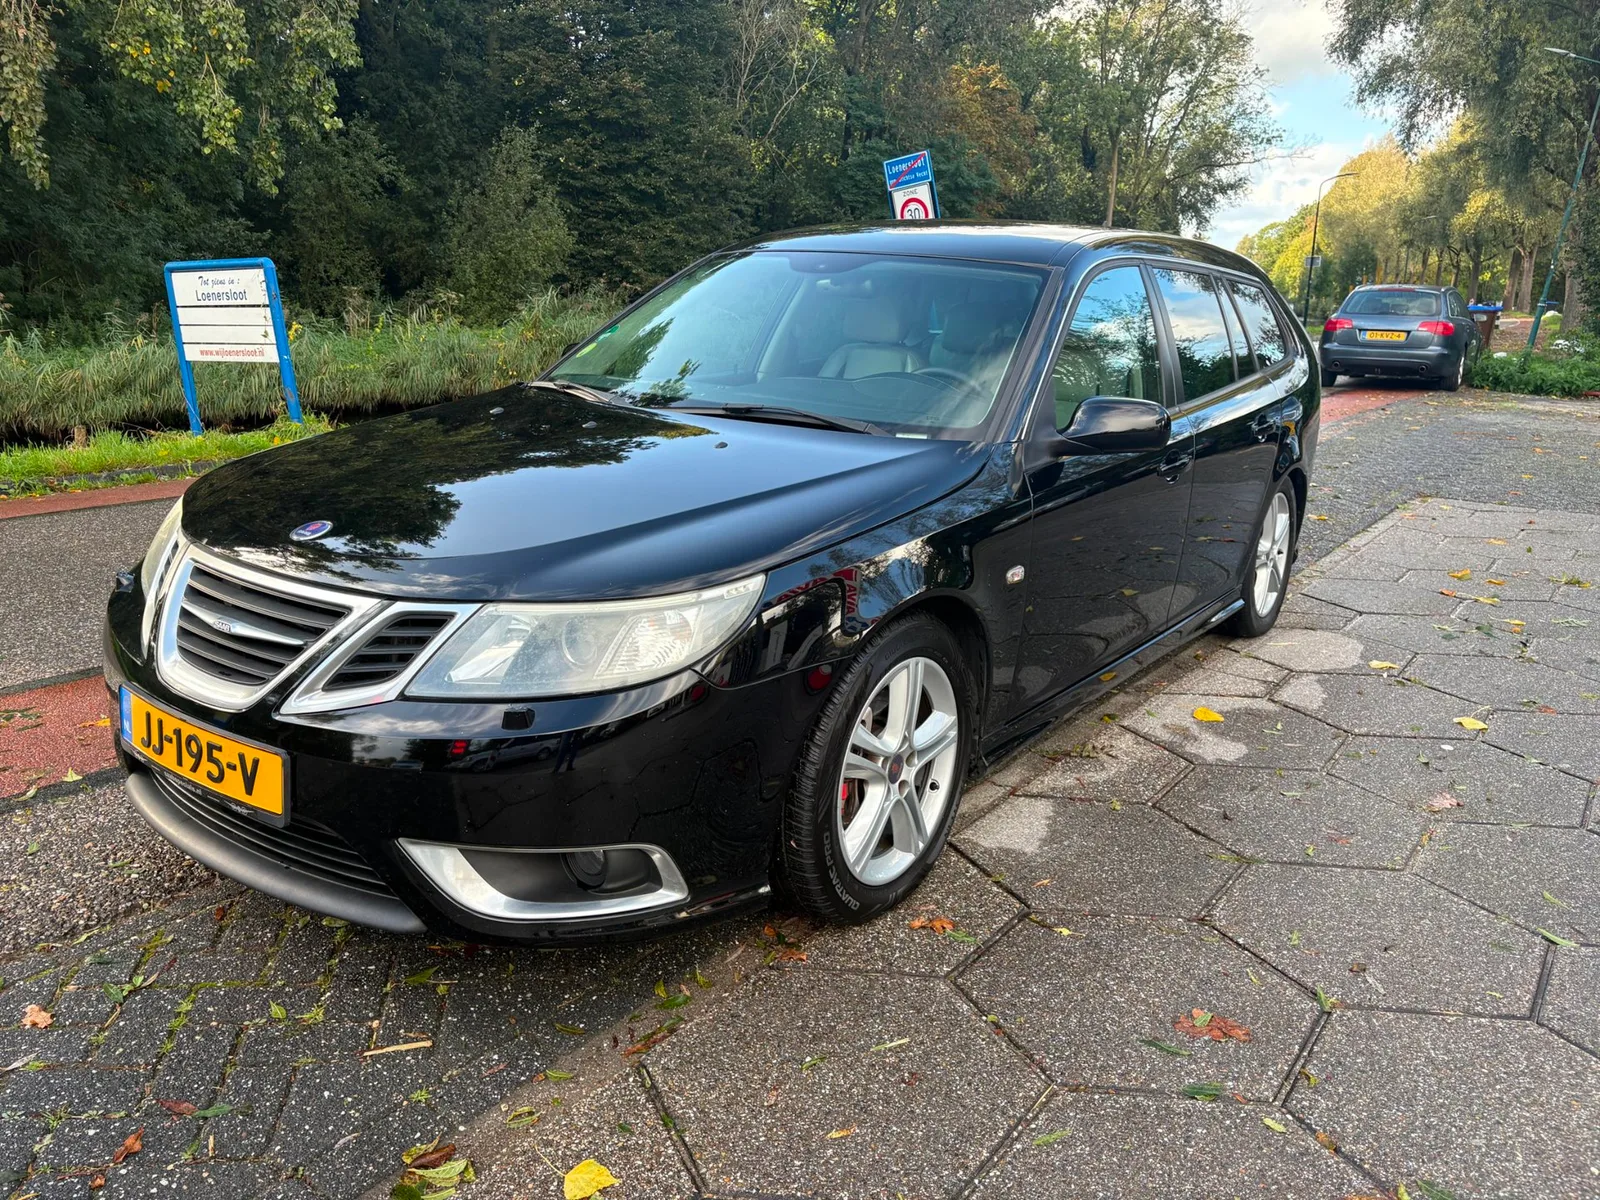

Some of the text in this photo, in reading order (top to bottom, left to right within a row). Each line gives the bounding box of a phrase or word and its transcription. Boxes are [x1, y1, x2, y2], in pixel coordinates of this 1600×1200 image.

[888, 157, 925, 174] Loenersloot
[903, 189, 918, 197] ZONE
[907, 207, 921, 219] 30
[198, 276, 209, 286] Tot
[195, 289, 248, 301] Loenersloot
[199, 347, 265, 358] www.wijloenersloot.nl
[123, 719, 131, 734] NL
[141, 710, 260, 796] JJ-195-V
[823, 831, 860, 911] QUATRAC PRO
